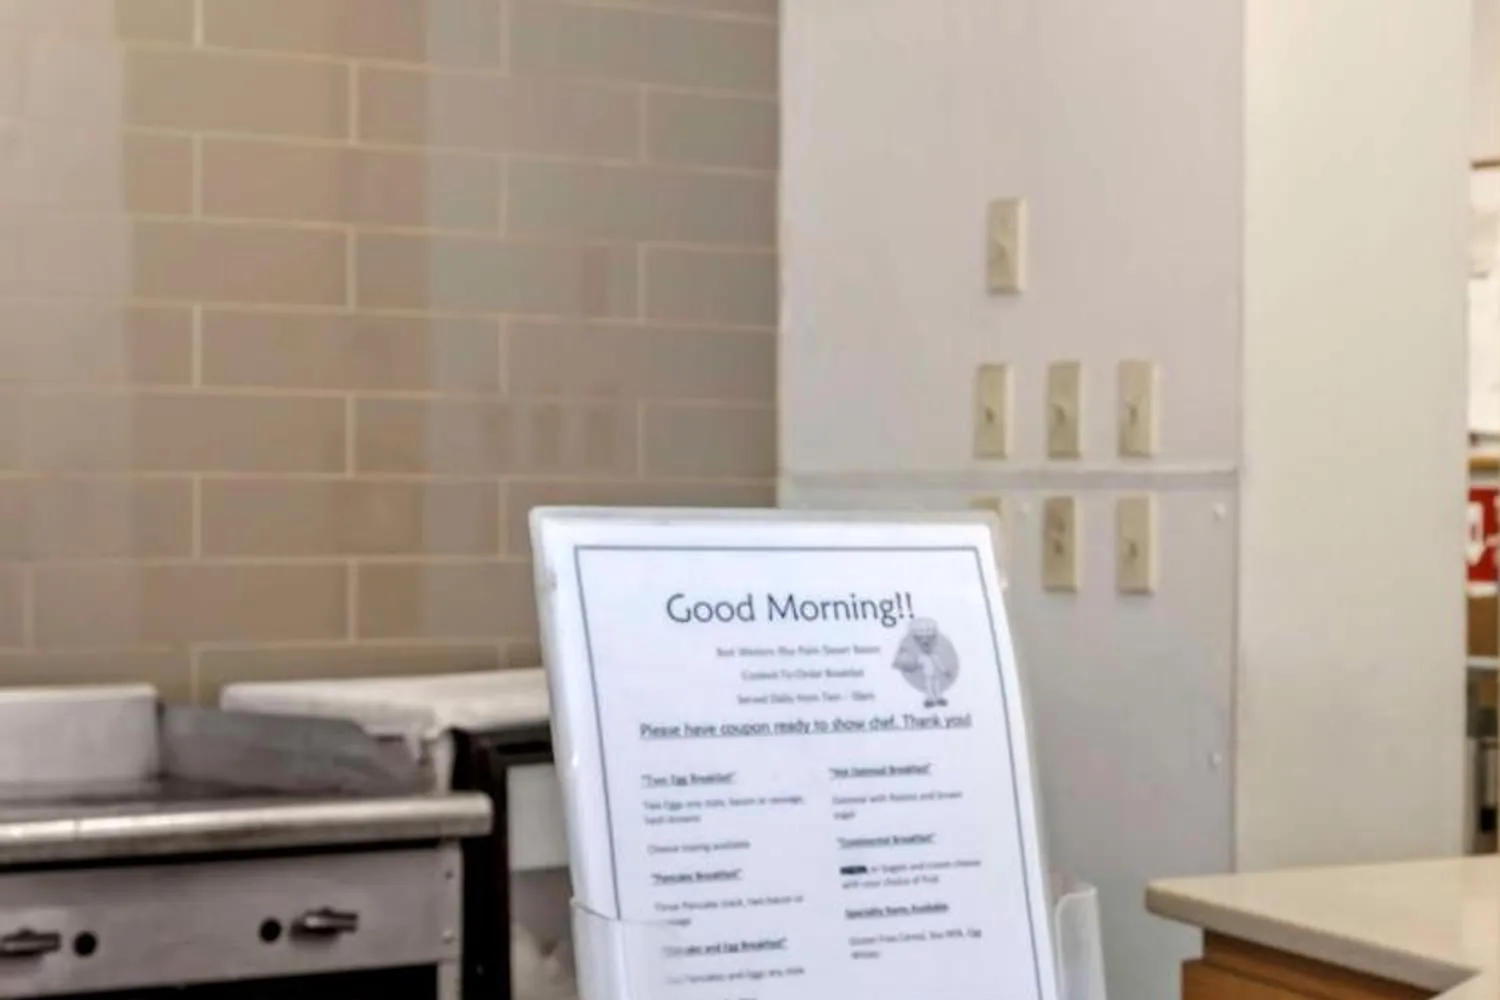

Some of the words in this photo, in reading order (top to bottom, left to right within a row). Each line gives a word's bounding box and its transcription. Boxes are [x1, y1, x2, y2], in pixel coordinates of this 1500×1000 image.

[666, 593, 756, 623] Good
[767, 592, 915, 628] Morning!!
[639, 723, 681, 738] Please
[684, 721, 717, 736] have
[720, 722, 770, 737] coupon
[773, 719, 811, 735] ready
[813, 719, 829, 732] to
[832, 717, 865, 732] show
[868, 714, 898, 731] chef.
[902, 713, 940, 729] Thank
